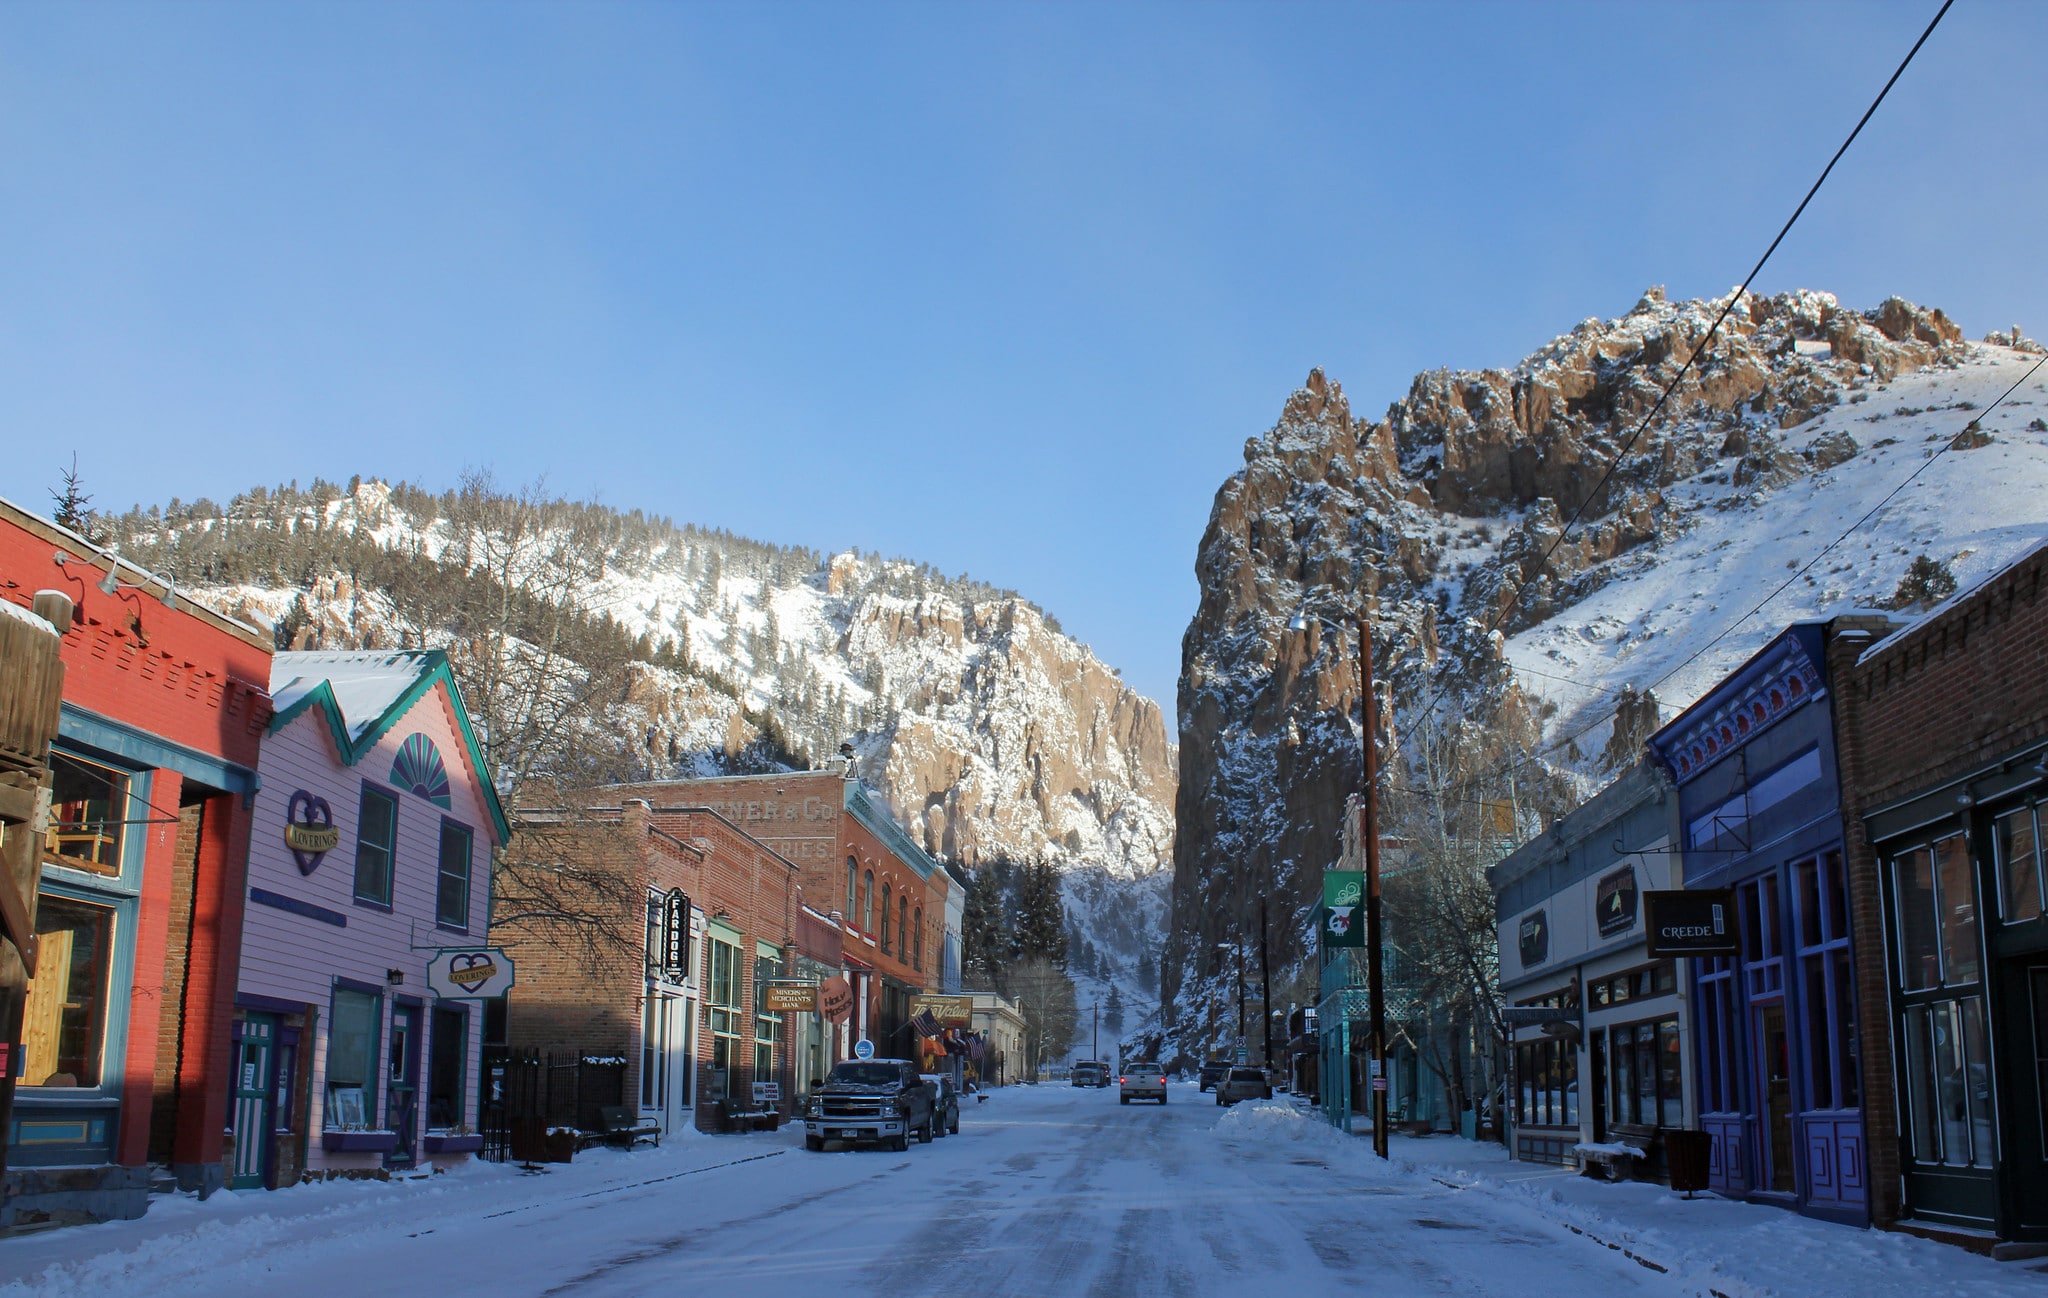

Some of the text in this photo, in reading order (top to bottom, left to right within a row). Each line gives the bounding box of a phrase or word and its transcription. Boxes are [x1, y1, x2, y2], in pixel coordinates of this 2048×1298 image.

[671, 899, 681, 929] FAR
[670, 930, 680, 961] DOG
[1661, 926, 1712, 940] CREEDE
